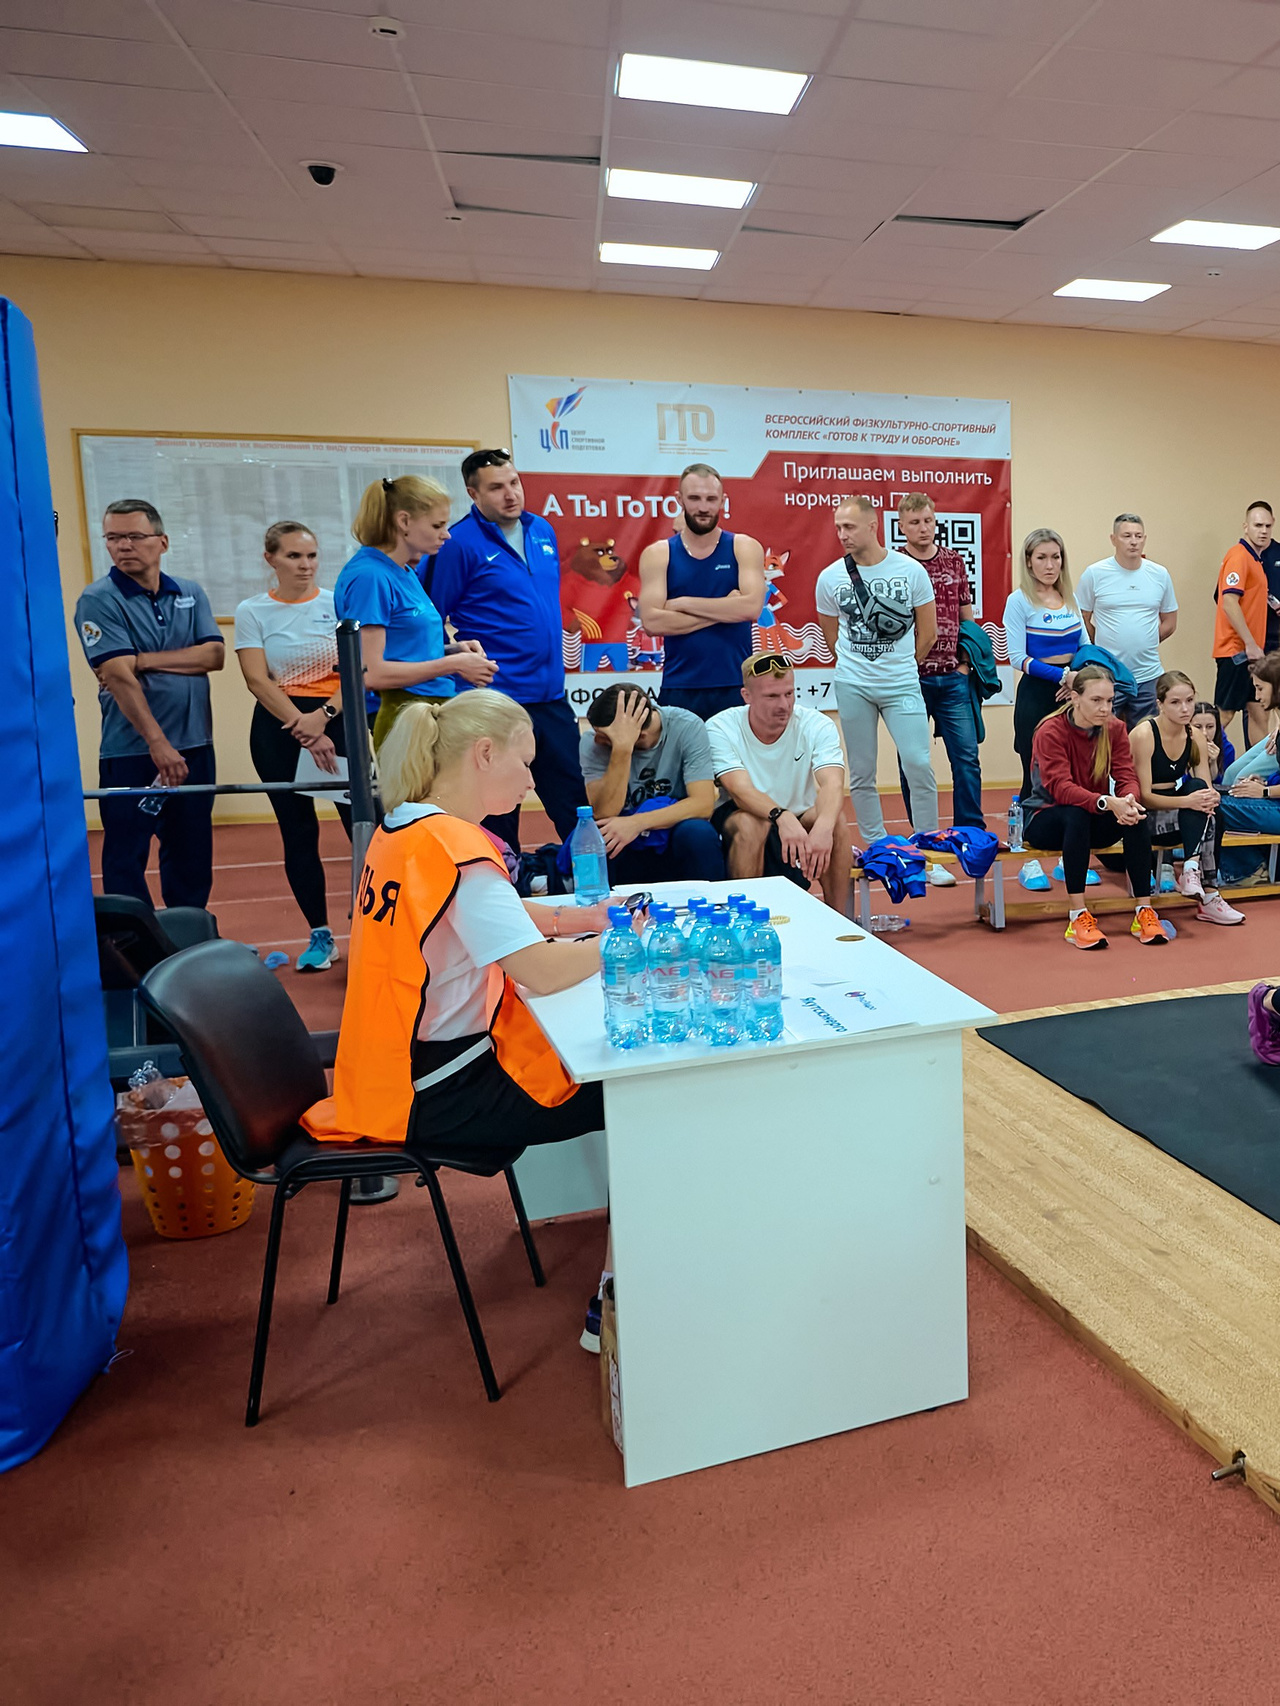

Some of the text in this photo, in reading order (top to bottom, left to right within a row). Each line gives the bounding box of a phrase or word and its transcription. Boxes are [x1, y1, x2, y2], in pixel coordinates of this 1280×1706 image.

[656, 403, 715, 442] ГТО
[765, 414, 996, 434] ВСЕРОССИЙСКИЙ ФИЗКУЛЬТУРНО-СПОРТИВНЫЙ
[765, 429, 961, 447] КОМПЛЕКС «ГОТОВ К ТРУДУ И ОБОРОНЕ»
[784, 461, 993, 485] Приглашаем выполнить
[542, 494, 564, 517] А
[567, 494, 607, 518] Ты
[851, 642, 895, 653] КУЛЬТУРА
[808, 682, 831, 698] +7
